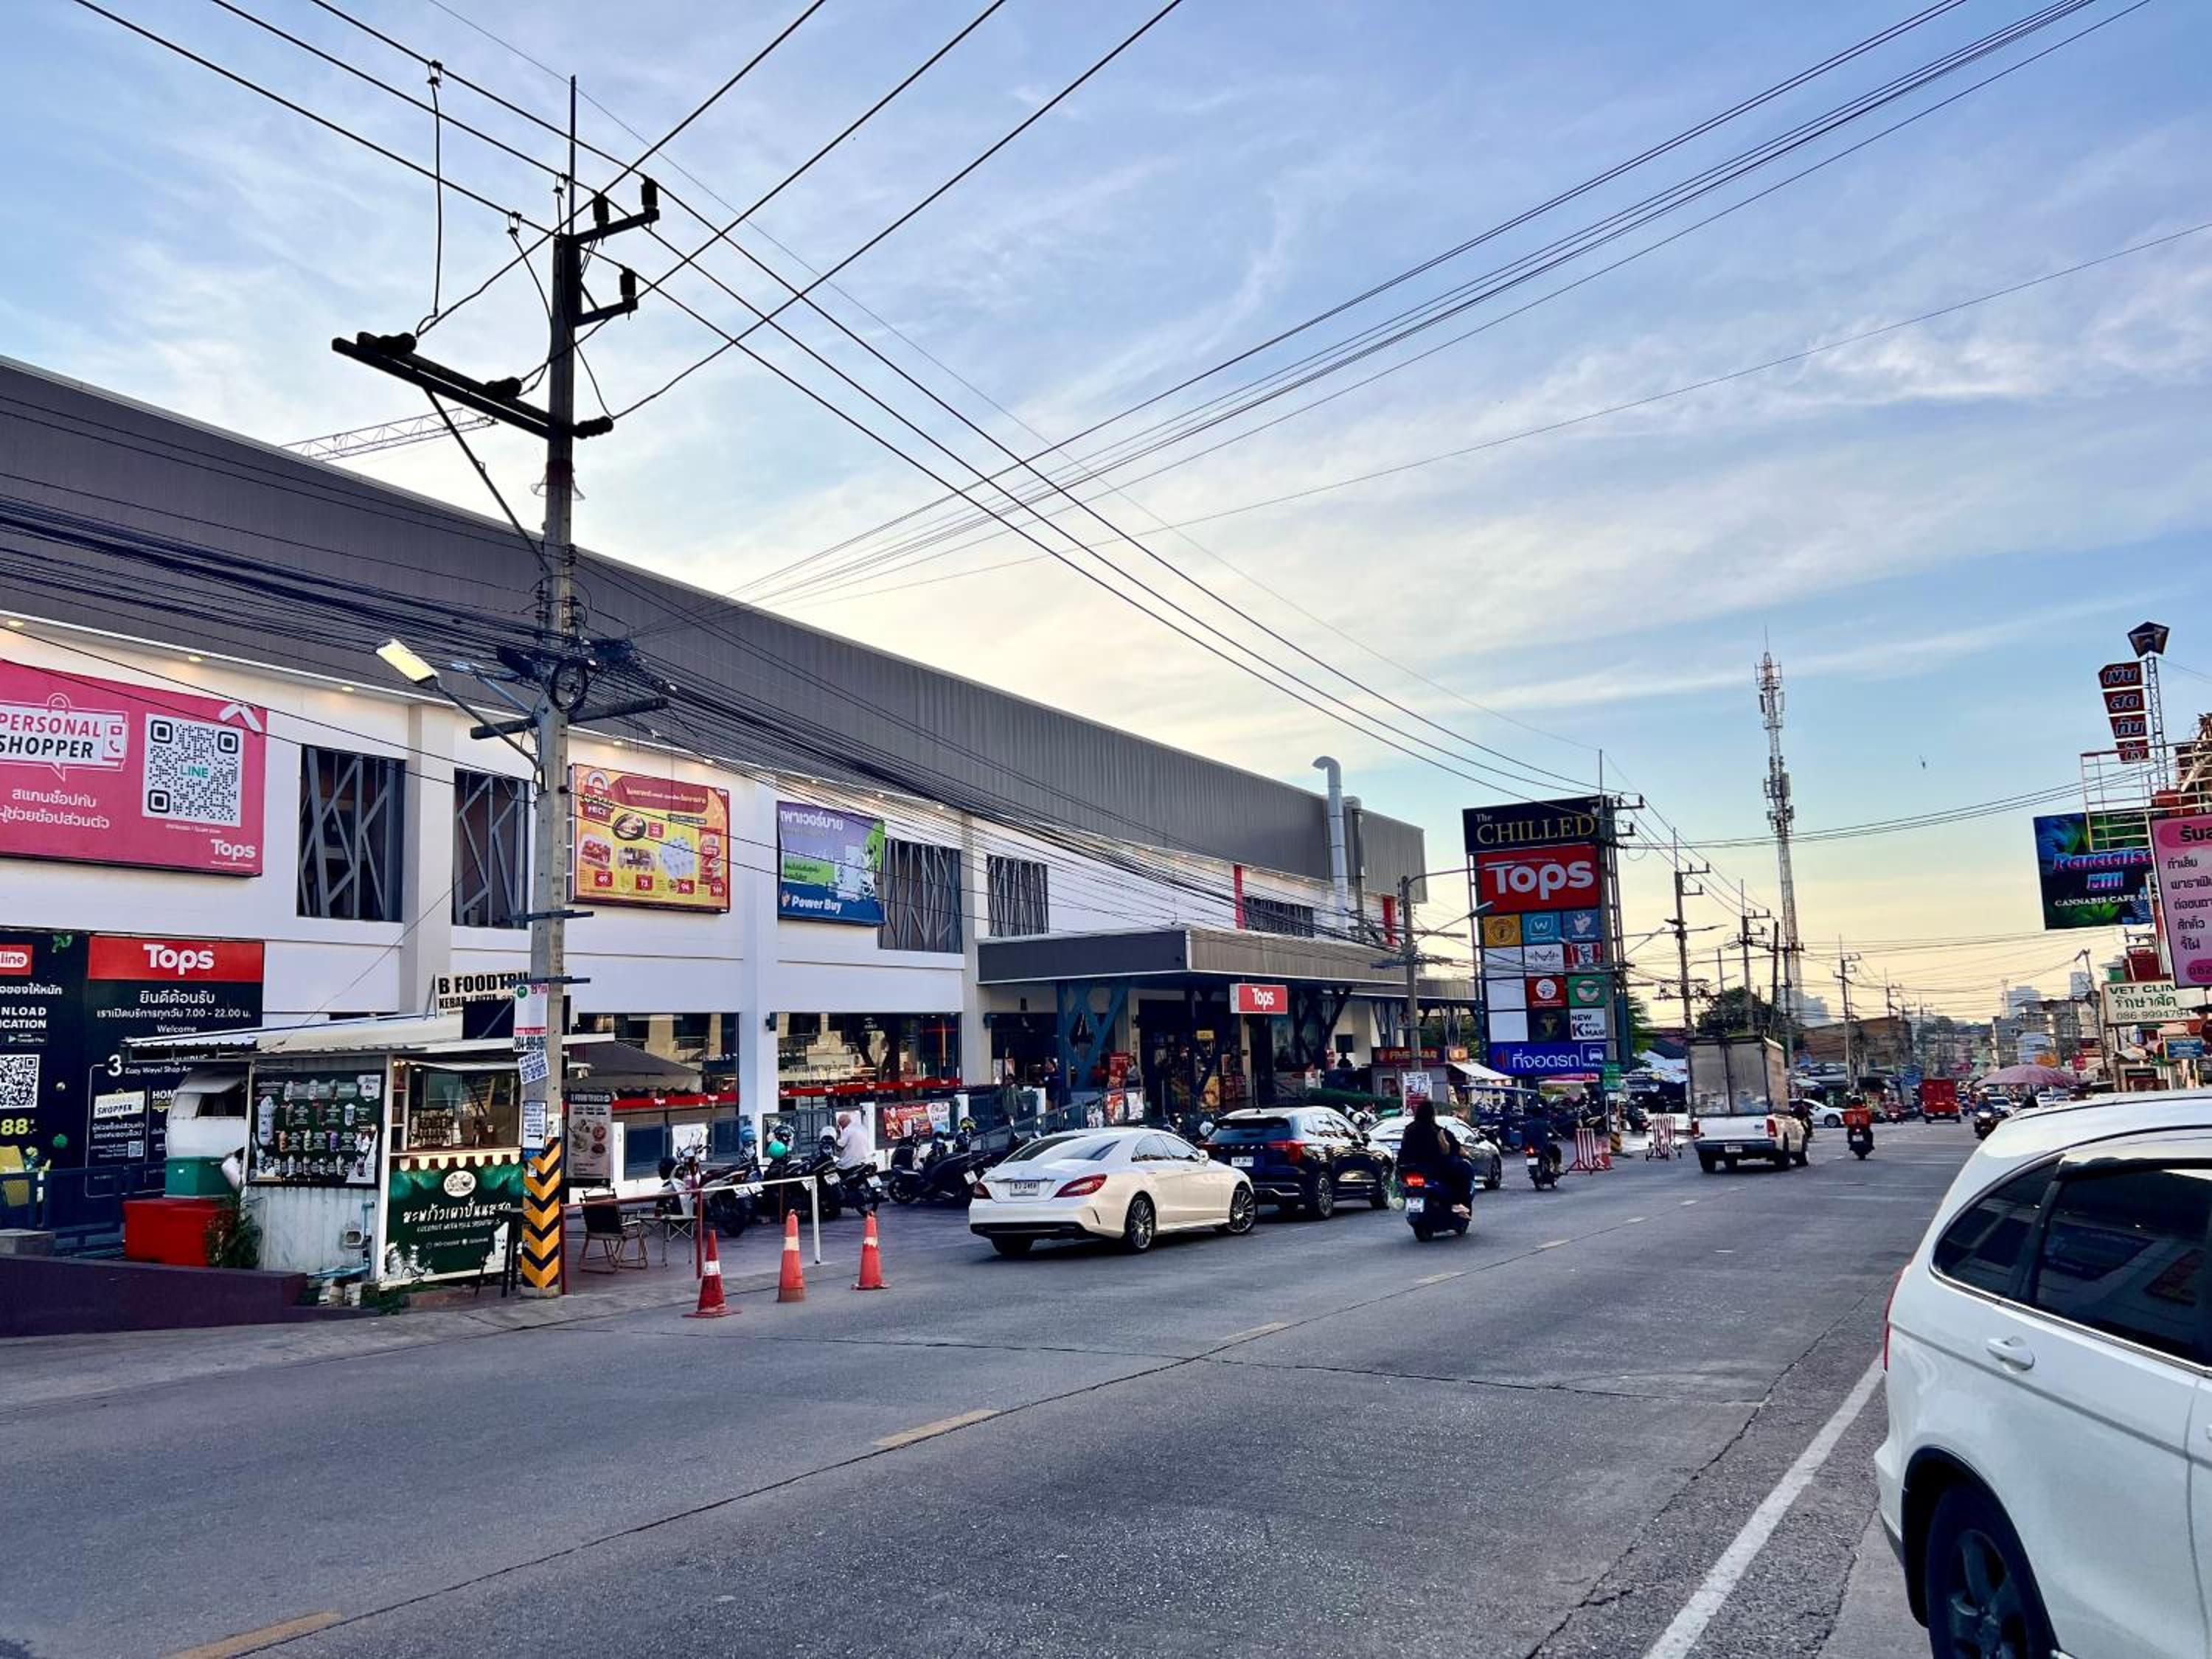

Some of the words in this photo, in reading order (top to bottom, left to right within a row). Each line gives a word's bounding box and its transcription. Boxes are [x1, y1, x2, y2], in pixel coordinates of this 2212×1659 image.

[0, 713, 100, 737] PERSONAL
[180, 766, 209, 779] LINE
[1476, 813, 1492, 822] The
[1477, 815, 1596, 844] CHILLED
[210, 838, 256, 860] Tops
[1485, 860, 1593, 900] Tops
[792, 895, 824, 909] Power
[824, 898, 842, 914] Buy
[143, 944, 214, 975] Tops
[438, 978, 451, 995] B
[2110, 986, 2136, 995] VET
[139, 990, 215, 1004] ยินดีต้อนรับ
[1251, 987, 1275, 1010] Tops
[1, 1006, 47, 1016] NLOAD
[157, 1025, 197, 1033] Welcome
[107, 1054, 122, 1077] 3
[1512, 1048, 1580, 1068] ที่จอดรถ
